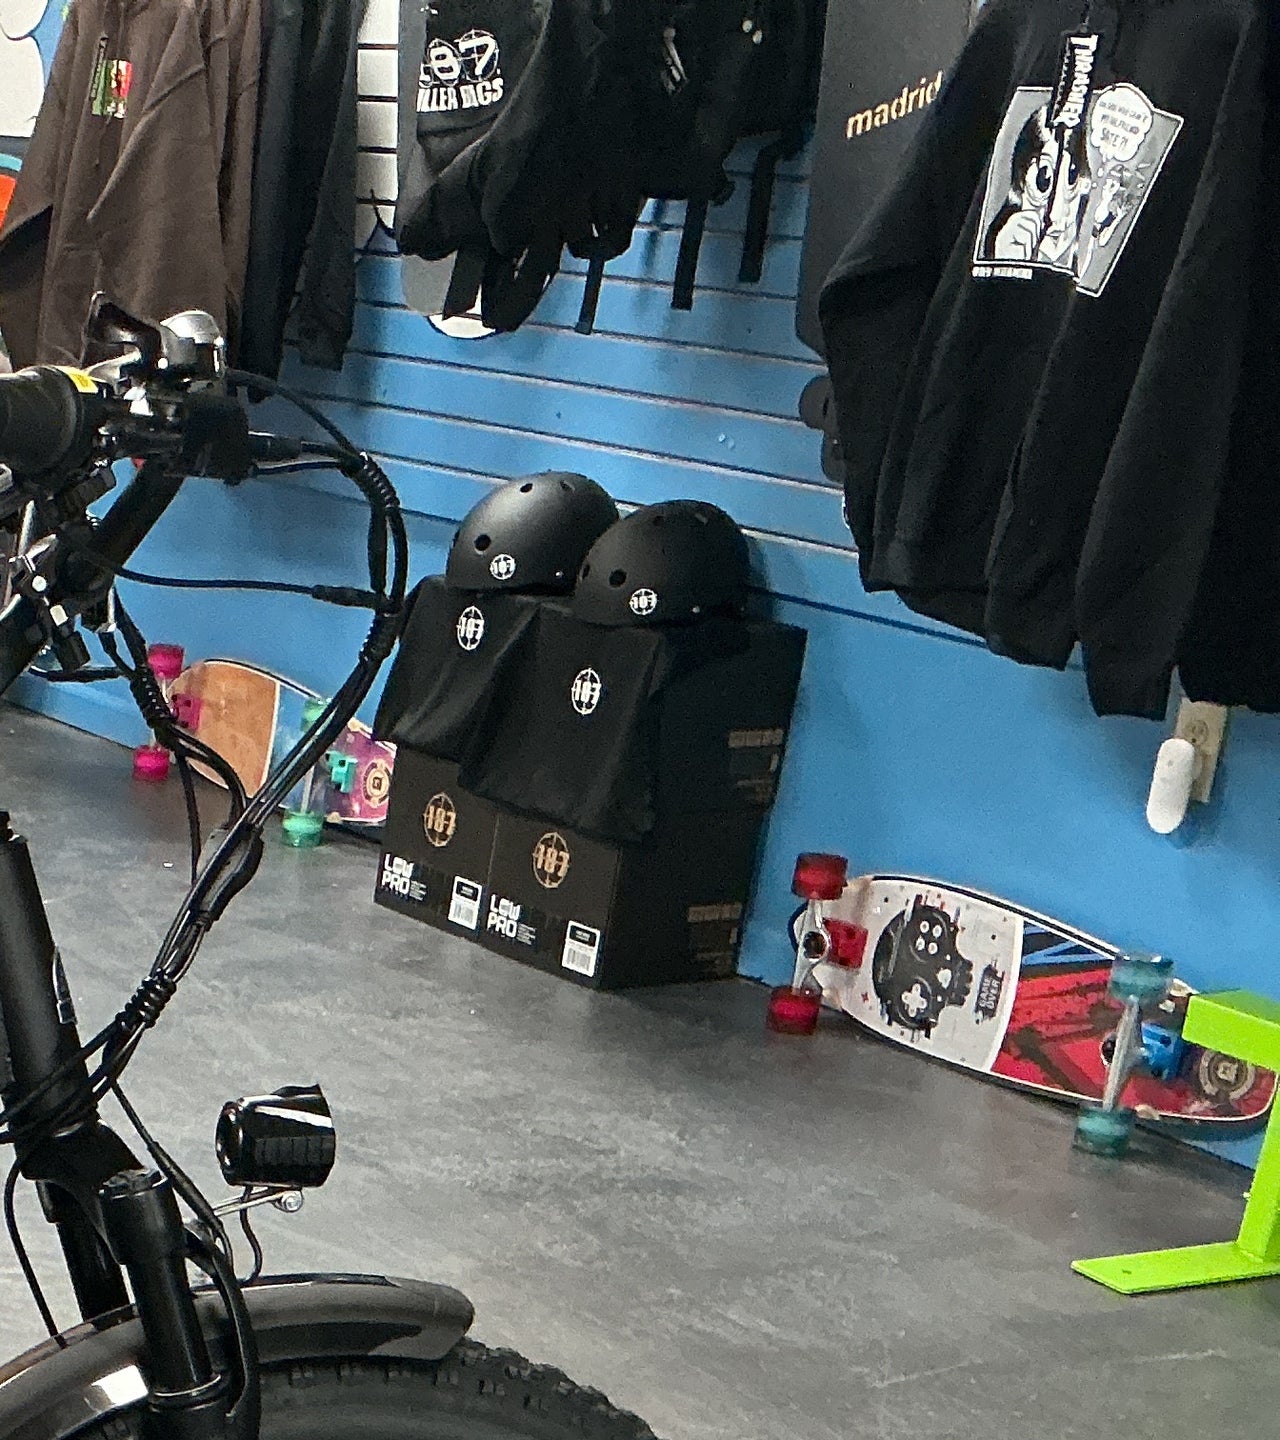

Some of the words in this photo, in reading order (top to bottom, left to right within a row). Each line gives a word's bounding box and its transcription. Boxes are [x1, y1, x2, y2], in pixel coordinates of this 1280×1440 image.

[846, 69, 943, 139] madrid
[424, 804, 457, 836] 187
[535, 844, 570, 878] 187
[381, 870, 411, 895] PRO
[487, 911, 518, 938] PRO
